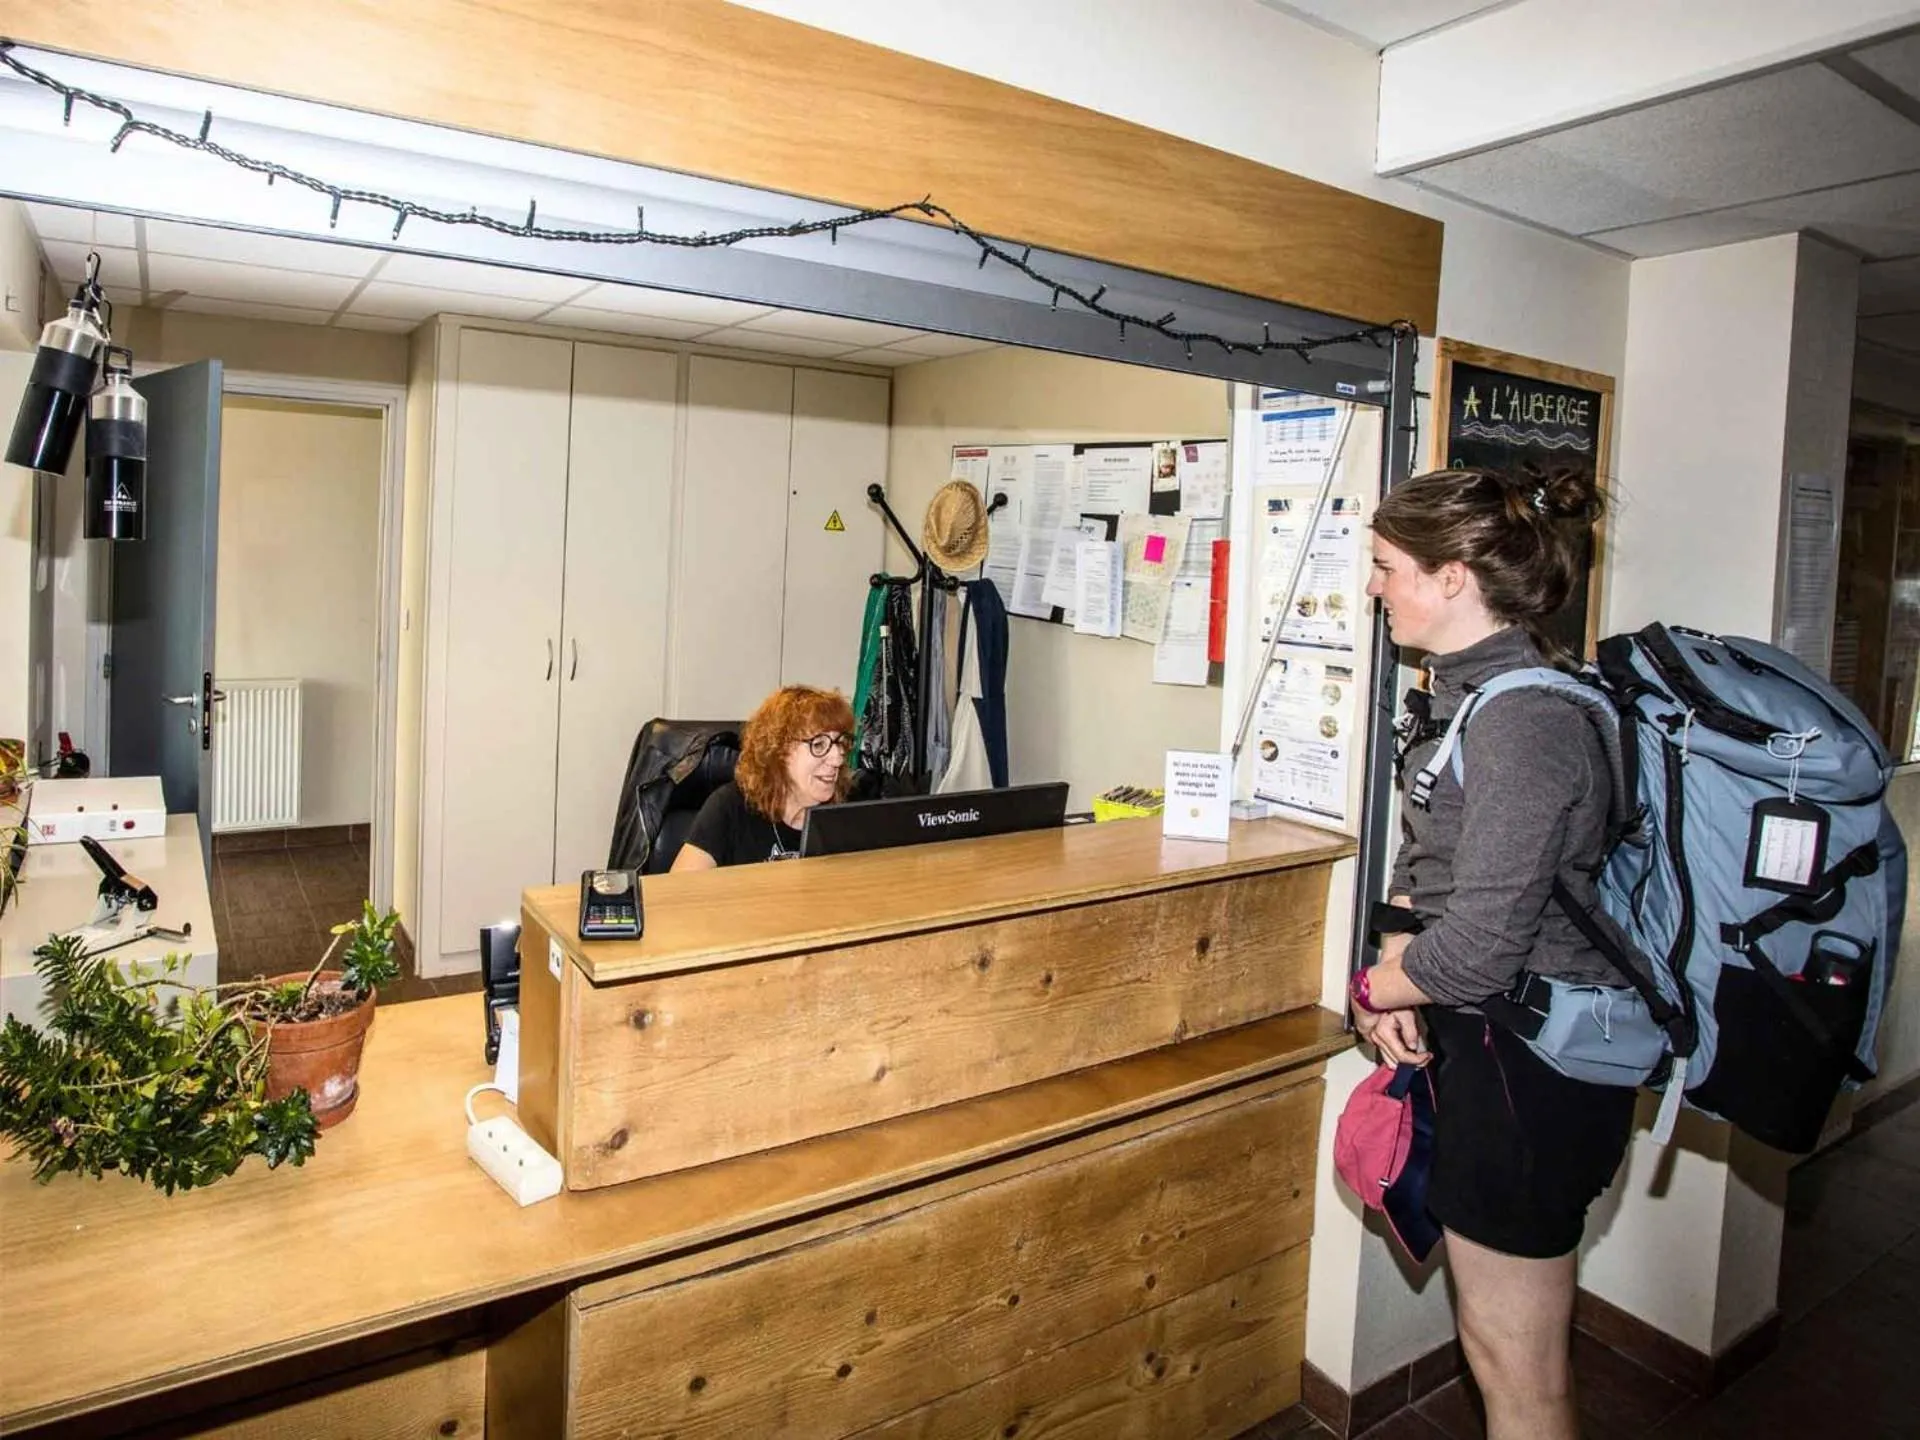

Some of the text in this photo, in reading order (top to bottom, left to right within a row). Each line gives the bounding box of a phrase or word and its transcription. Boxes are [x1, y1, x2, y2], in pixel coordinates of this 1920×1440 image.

[1463, 384, 1588, 426] A L'AUBERGE
[917, 808, 980, 827] ViewSonic
